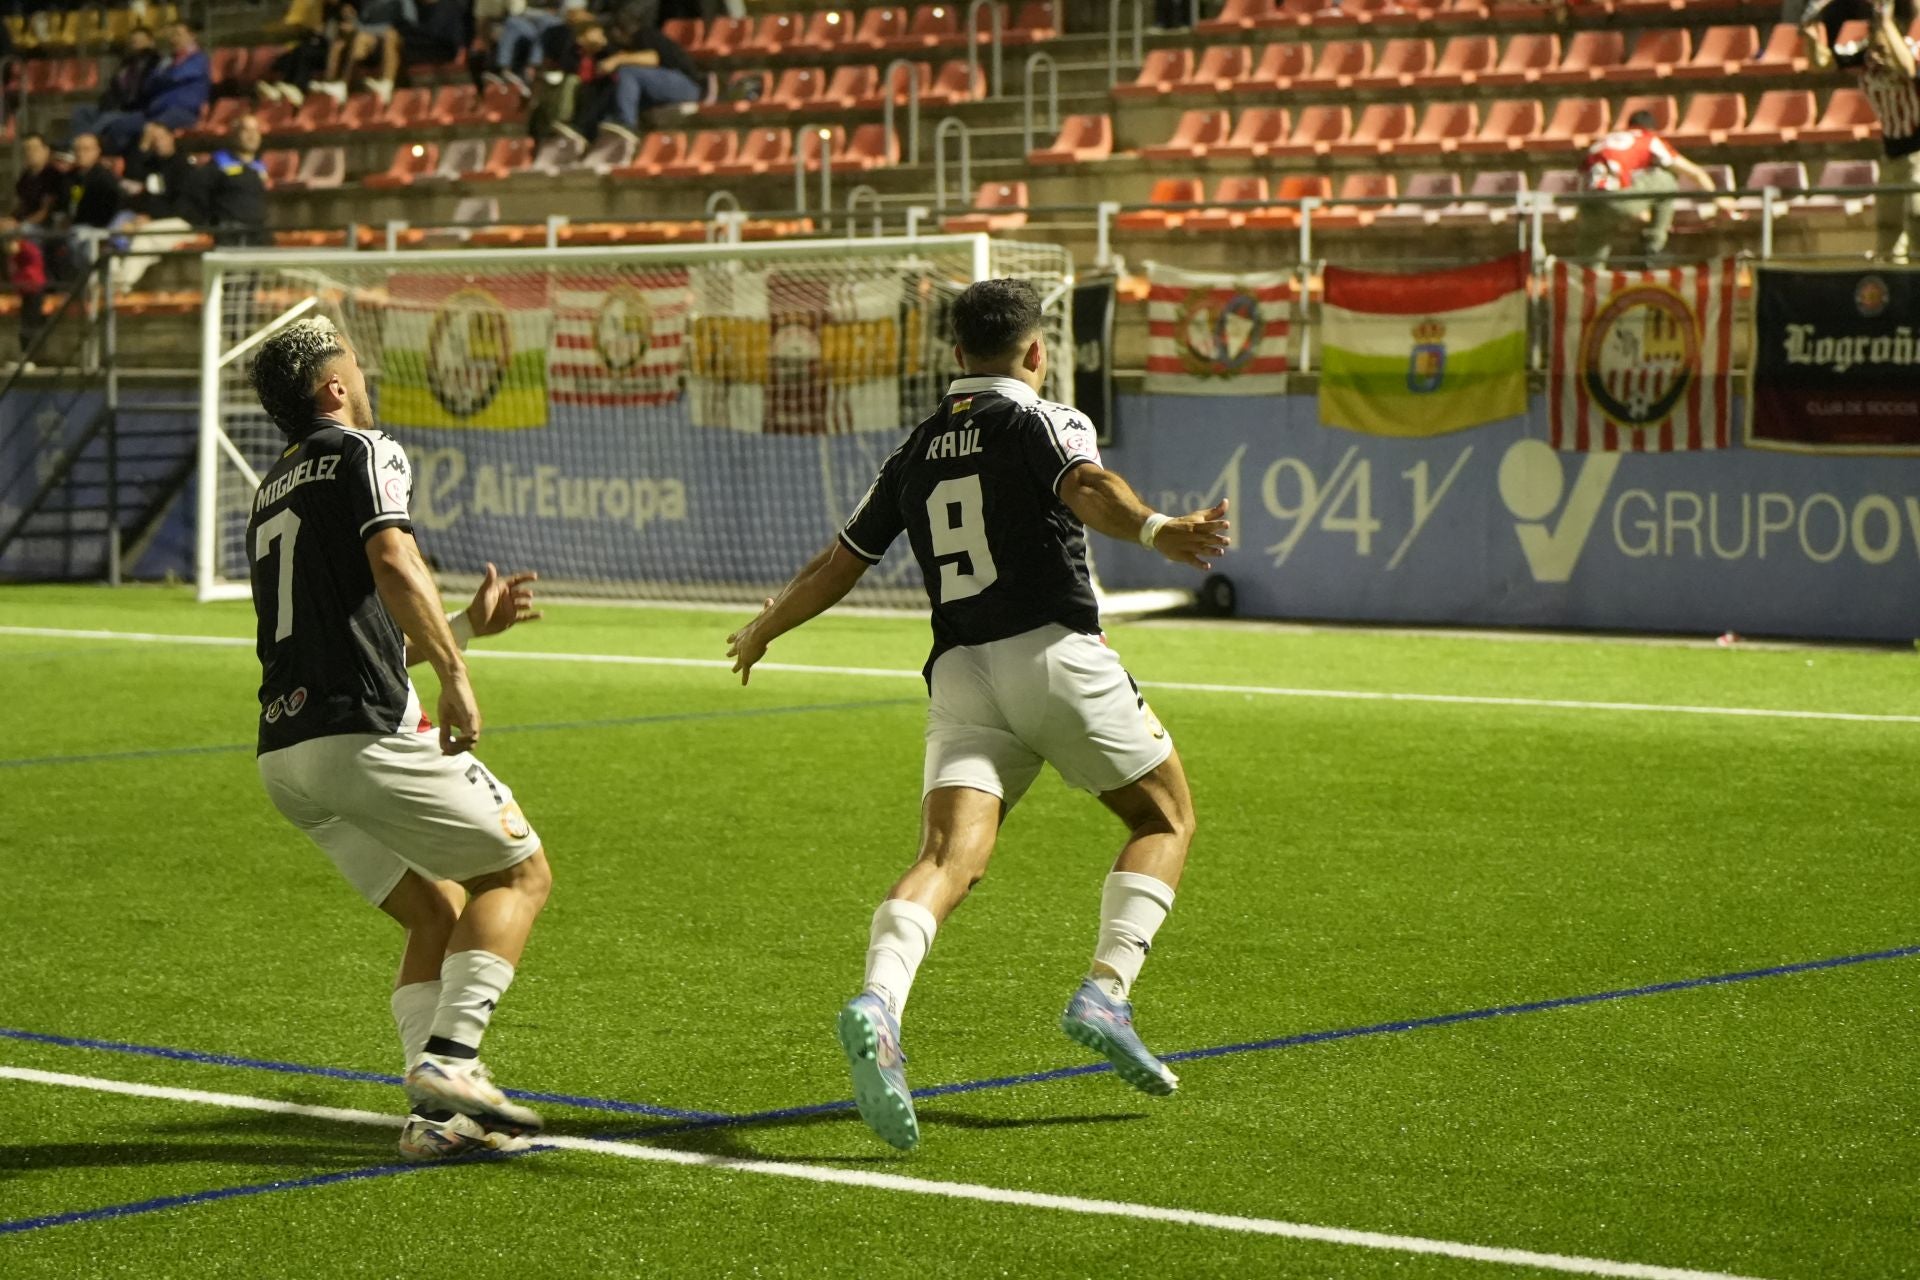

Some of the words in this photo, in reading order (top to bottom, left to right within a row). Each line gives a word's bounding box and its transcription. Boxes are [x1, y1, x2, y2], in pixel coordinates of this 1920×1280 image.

[926, 419, 983, 461] RAÚL
[256, 454, 342, 513] MIGUELEZ
[473, 463, 687, 530] AirEuropa
[926, 473, 998, 604] 9
[255, 507, 301, 643] 7
